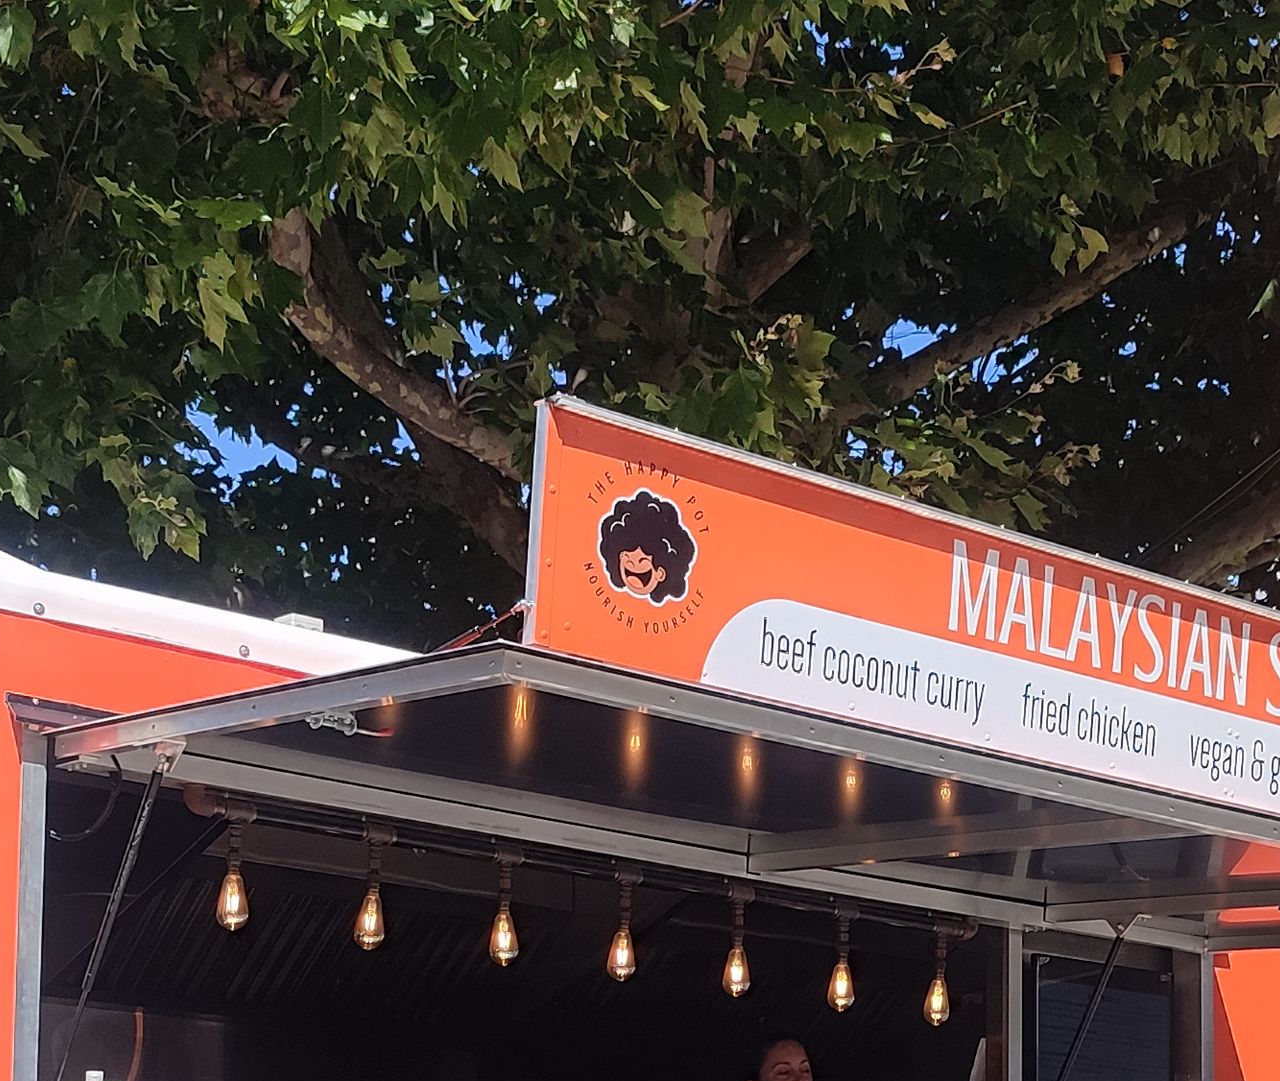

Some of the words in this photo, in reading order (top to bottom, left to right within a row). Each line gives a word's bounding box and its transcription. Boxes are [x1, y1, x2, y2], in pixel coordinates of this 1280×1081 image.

[587, 471, 615, 504] THE
[624, 460, 680, 489] HAPPY
[686, 495, 710, 534] POT
[583, 562, 634, 629] NOURISH
[644, 588, 705, 635] YOURSELF
[948, 538, 1251, 707] MALAYSIAN
[760, 617, 817, 677] beef
[822, 645, 920, 703] coconut
[926, 670, 986, 726] curry
[1022, 682, 1071, 740] fried
[1077, 692, 1157, 758] chicken
[1189, 733, 1245, 783] vegan
[1251, 739, 1266, 782] &
